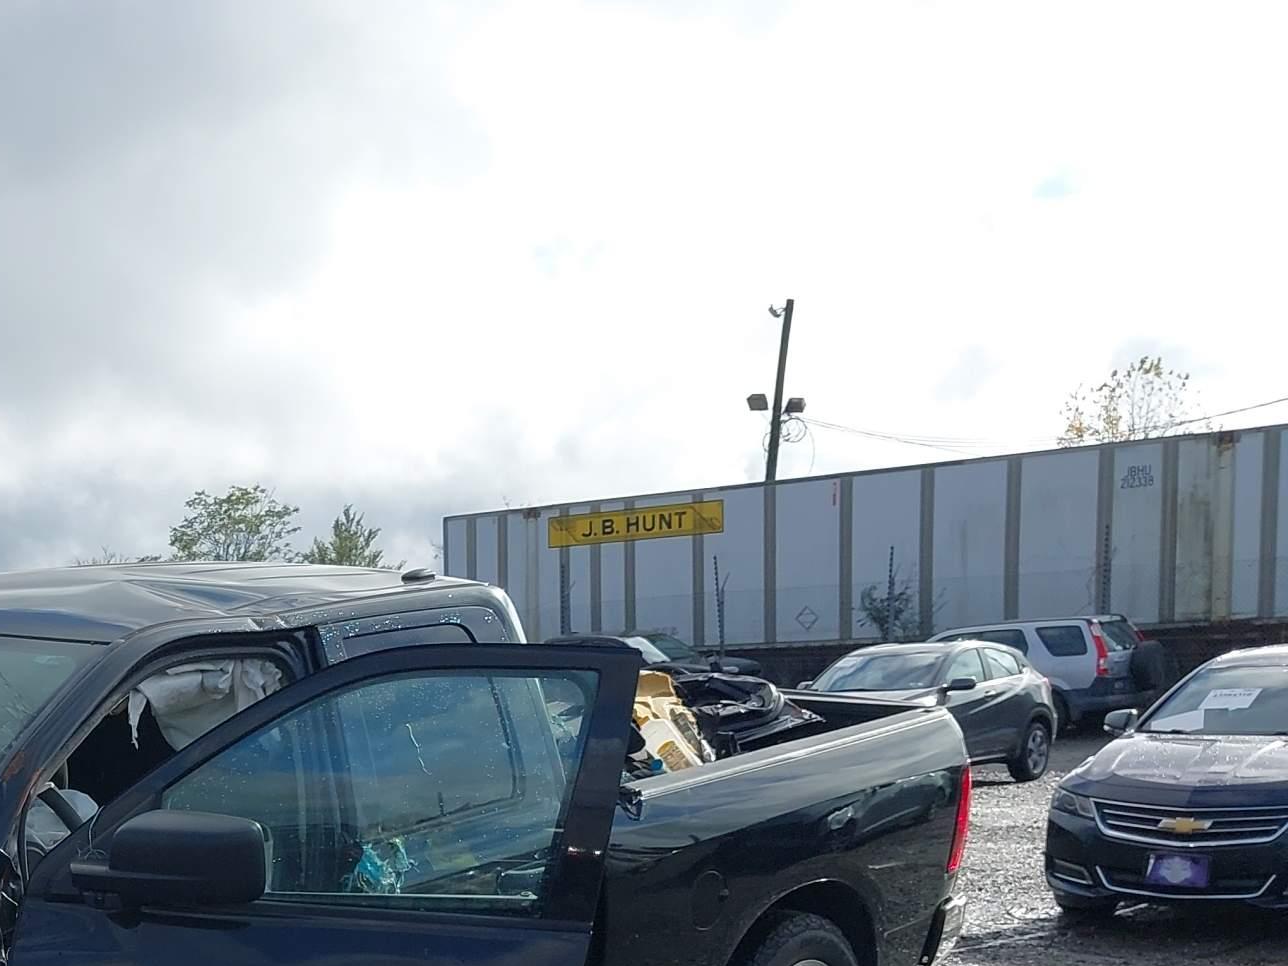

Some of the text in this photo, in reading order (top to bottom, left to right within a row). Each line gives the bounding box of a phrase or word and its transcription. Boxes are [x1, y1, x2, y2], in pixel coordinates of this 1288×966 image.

[1123, 464, 1152, 478] JBHU
[581, 511, 687, 537] J.B. HUNT
